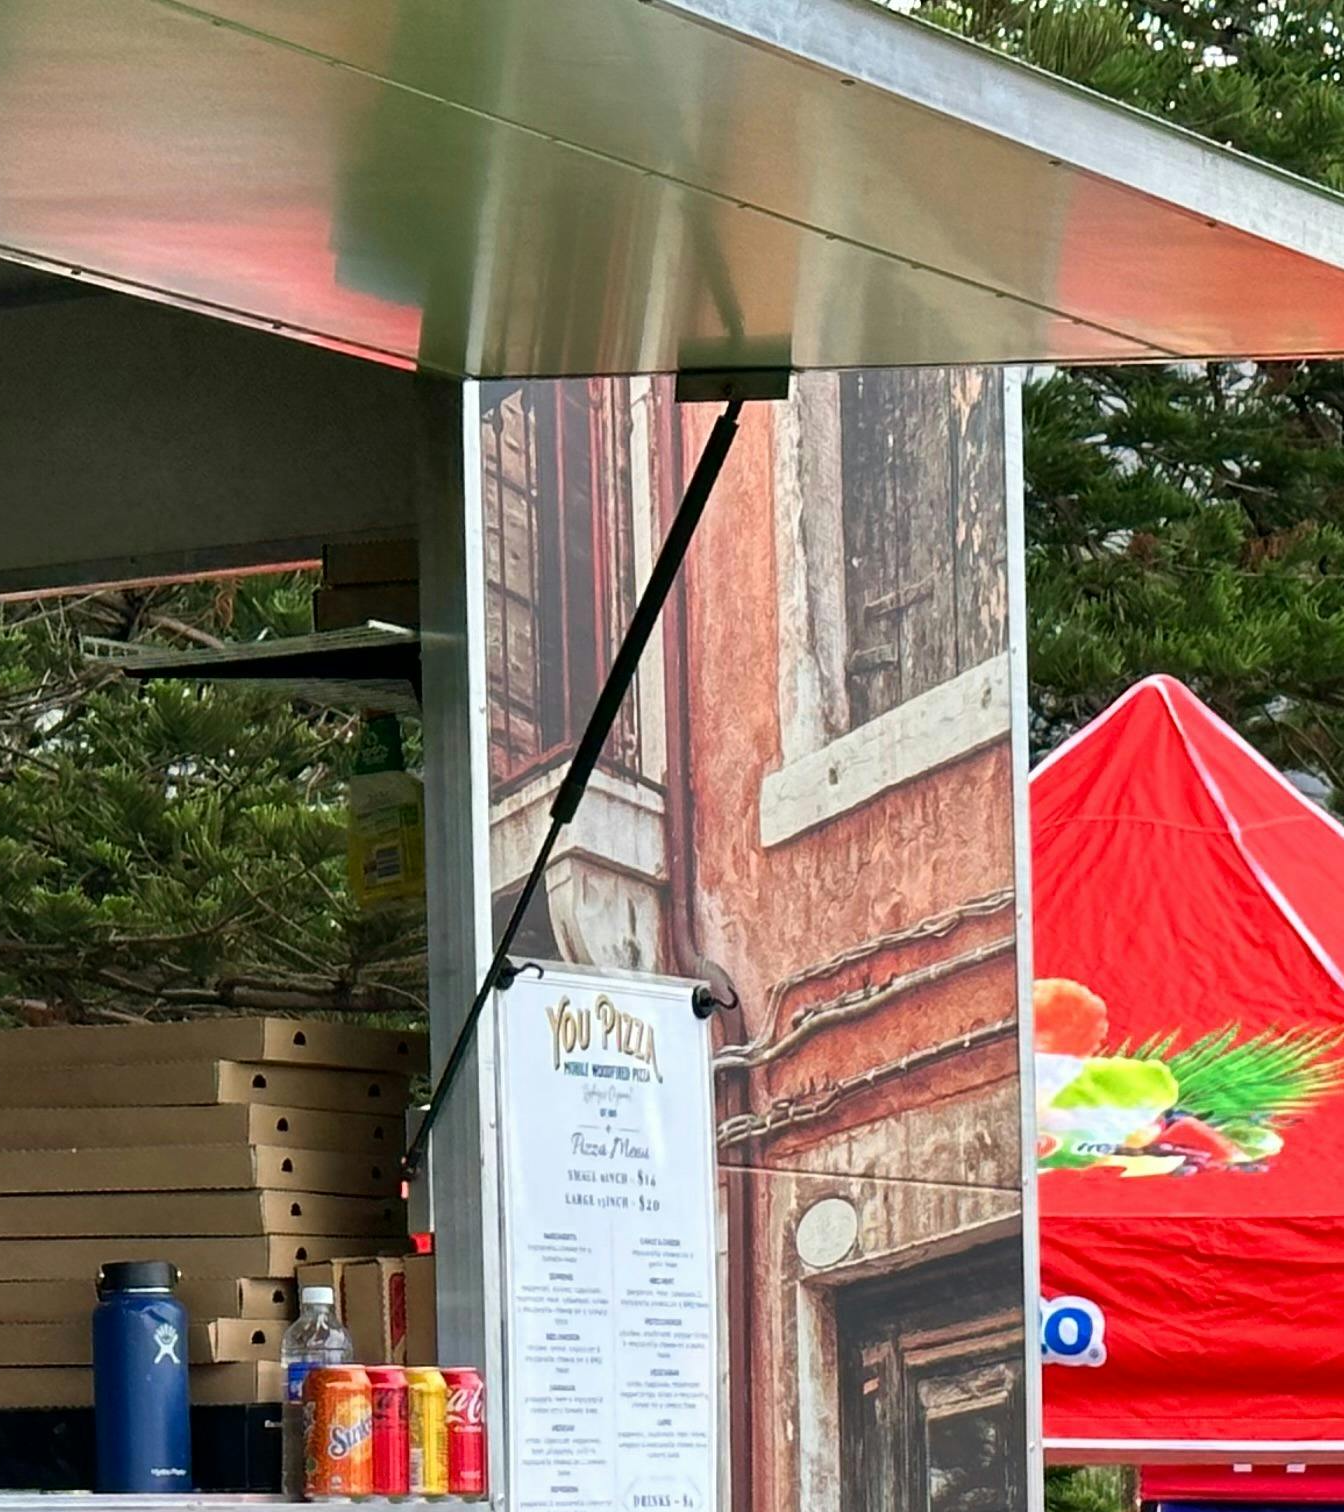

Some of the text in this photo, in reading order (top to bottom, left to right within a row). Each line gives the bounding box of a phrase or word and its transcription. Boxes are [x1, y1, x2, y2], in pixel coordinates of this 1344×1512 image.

[545, 993, 664, 1084] YOU PIZZA
[571, 1131, 649, 1160] Pizza Menu
[633, 1494, 671, 1509] DRINKS
